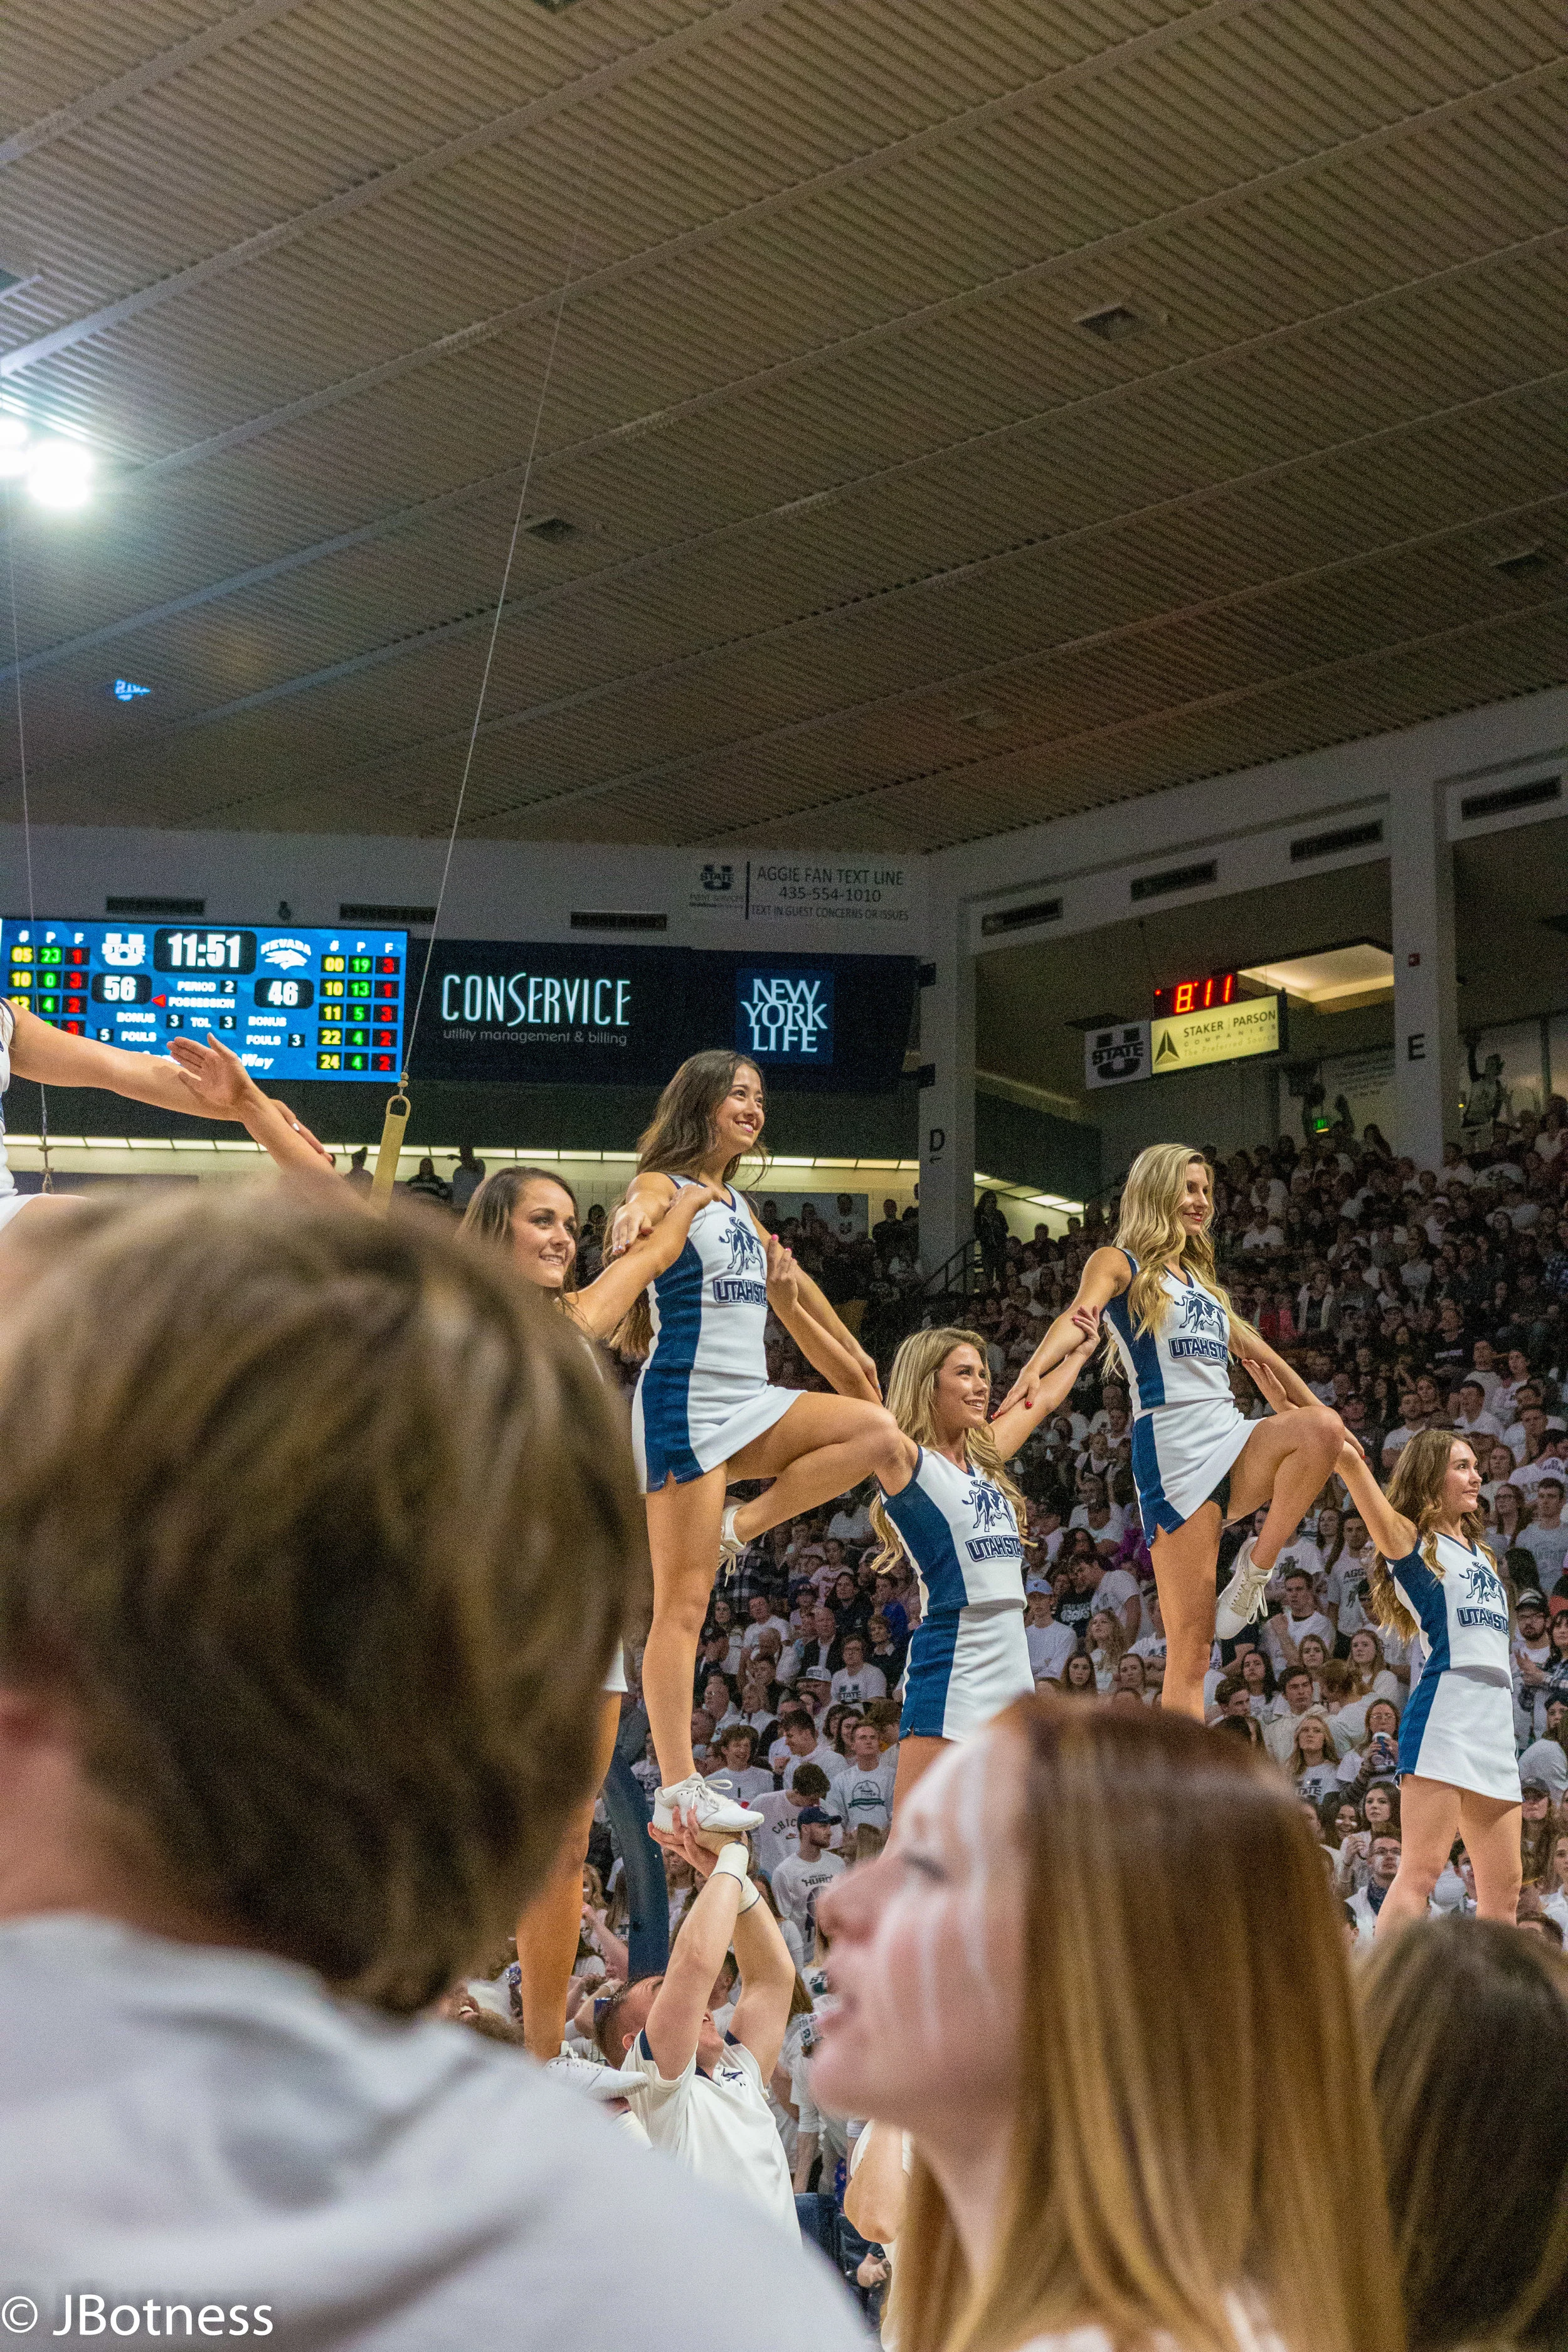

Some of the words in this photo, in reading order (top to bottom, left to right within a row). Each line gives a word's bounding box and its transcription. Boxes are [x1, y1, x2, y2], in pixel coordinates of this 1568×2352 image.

[757, 866, 800, 882] AGGIE
[805, 868, 832, 883] FAN
[837, 869, 869, 884] TEXT
[874, 870, 904, 886] LINE
[778, 886, 882, 902] 435-554-1010
[751, 904, 771, 915] TEXT
[774, 906, 783, 916] IN
[785, 906, 813, 918] GUEST
[816, 907, 862, 919] CONCERNS
[46, 931, 56, 943] P
[75, 933, 84, 944] F
[12, 947, 32, 962] 05
[41, 947, 61, 963] 23
[72, 949, 82, 964] 1
[167, 933, 240, 967] 11:51
[260, 938, 312, 956] NEVADA
[357, 942, 366, 952] P
[385, 943, 393, 953] F
[325, 956, 344, 972] 00
[352, 958, 371, 972] 19
[383, 958, 394, 973] 3
[12, 971, 31, 987] 10
[45, 972, 56, 988] 0
[70, 972, 82, 988] 3
[177, 981, 216, 992] PERIOD
[225, 980, 233, 993] 2
[103, 975, 137, 1002] 56
[268, 980, 299, 1006] 46
[326, 981, 343, 996] 10
[351, 981, 369, 997] 13
[383, 983, 392, 997] 1
[753, 978, 821, 1004] NEW
[42, 997, 55, 1012] 4
[68, 998, 80, 1013] 2
[169, 997, 235, 1009] POSSESSION
[117, 1012, 156, 1023] BONUS
[170, 1014, 179, 1027] 3
[191, 1017, 211, 1028] TOL
[224, 1016, 233, 1028] 3
[248, 1015, 287, 1027] BONUS
[324, 1005, 341, 1020] 11
[353, 1006, 364, 1021] 5
[381, 1006, 392, 1022] 3
[740, 1001, 828, 1031] YORK
[1184, 1020, 1224, 1038] STAKER
[1233, 1010, 1276, 1027] PARSON
[100, 1029, 110, 1041] 5
[121, 1030, 157, 1042] FOULS
[246, 1035, 281, 1046] FOULS
[292, 1034, 300, 1046] 3
[321, 1030, 341, 1045] 22
[352, 1030, 363, 1046] 4
[380, 1031, 391, 1046] 2
[443, 1029, 476, 1042] utility
[480, 1030, 570, 1044] management
[574, 1030, 585, 1043] &
[588, 1031, 627, 1047] billing
[753, 1025, 818, 1052] LIFE
[1184, 1024, 1276, 1047] COMPANIES
[1092, 1041, 1143, 1066] STATE
[1407, 1033, 1426, 1061] E
[240, 1054, 274, 1069] Way
[320, 1054, 340, 1069] 24
[352, 1055, 363, 1070] 4
[379, 1056, 389, 1071] 2
[929, 1129, 945, 1152] D
